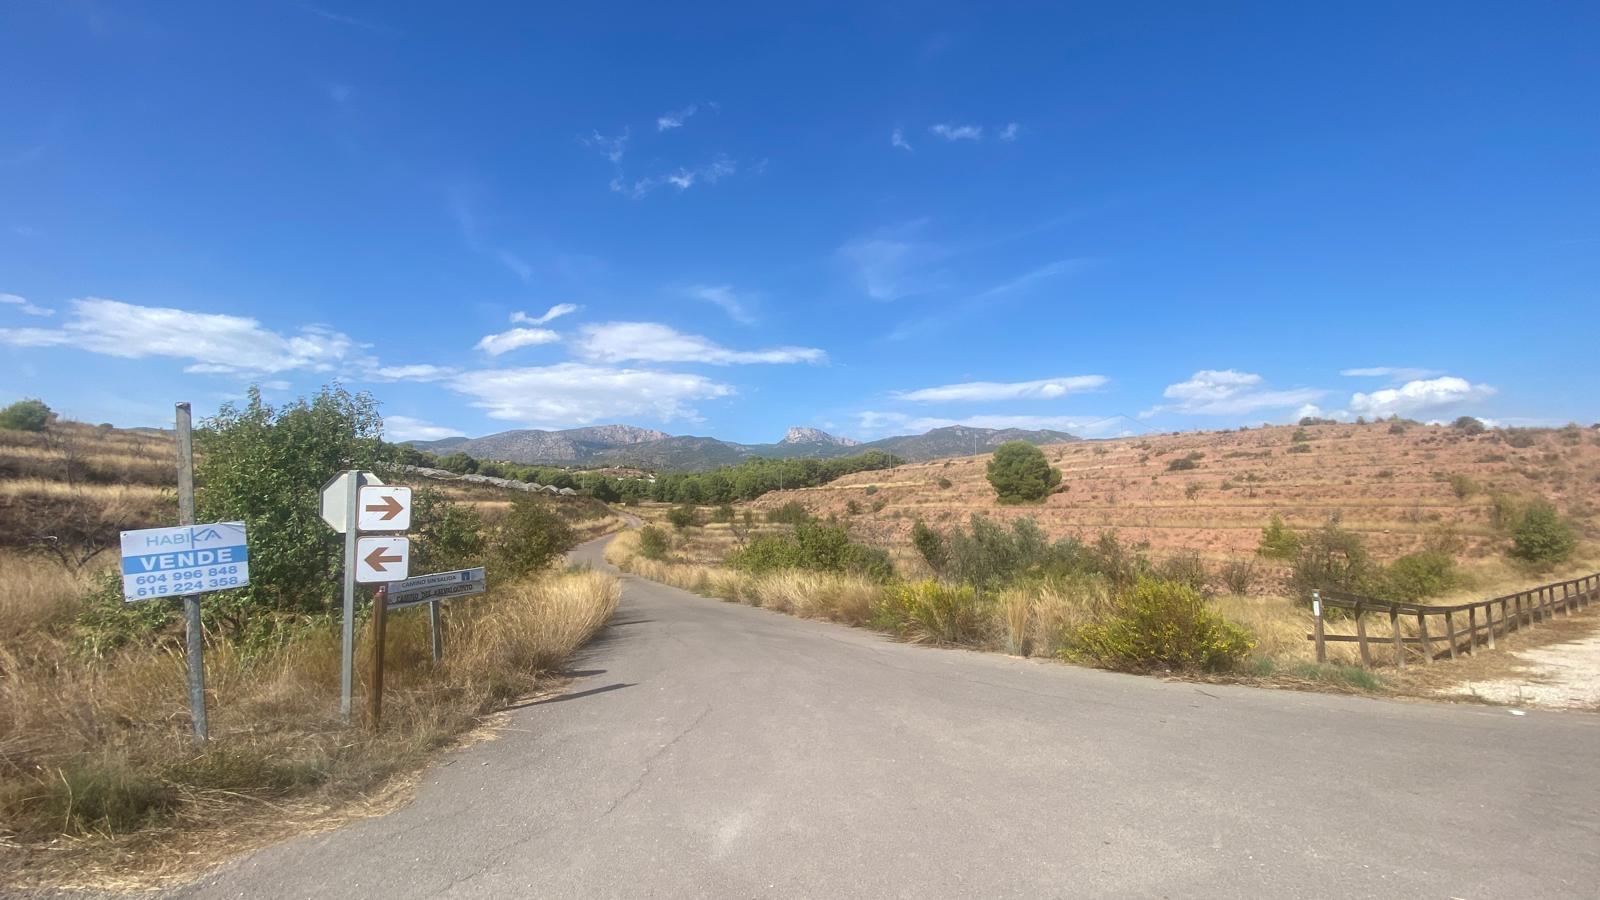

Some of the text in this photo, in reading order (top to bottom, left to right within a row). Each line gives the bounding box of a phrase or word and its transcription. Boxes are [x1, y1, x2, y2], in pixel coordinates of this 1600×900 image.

[146, 528, 222, 549] HABIKA
[140, 548, 233, 571] VENDE
[136, 565, 238, 585] 604 996 848
[401, 579, 426, 588] CAMINO
[436, 575, 457, 583] SALIDA
[136, 576, 238, 596] 615 224 358
